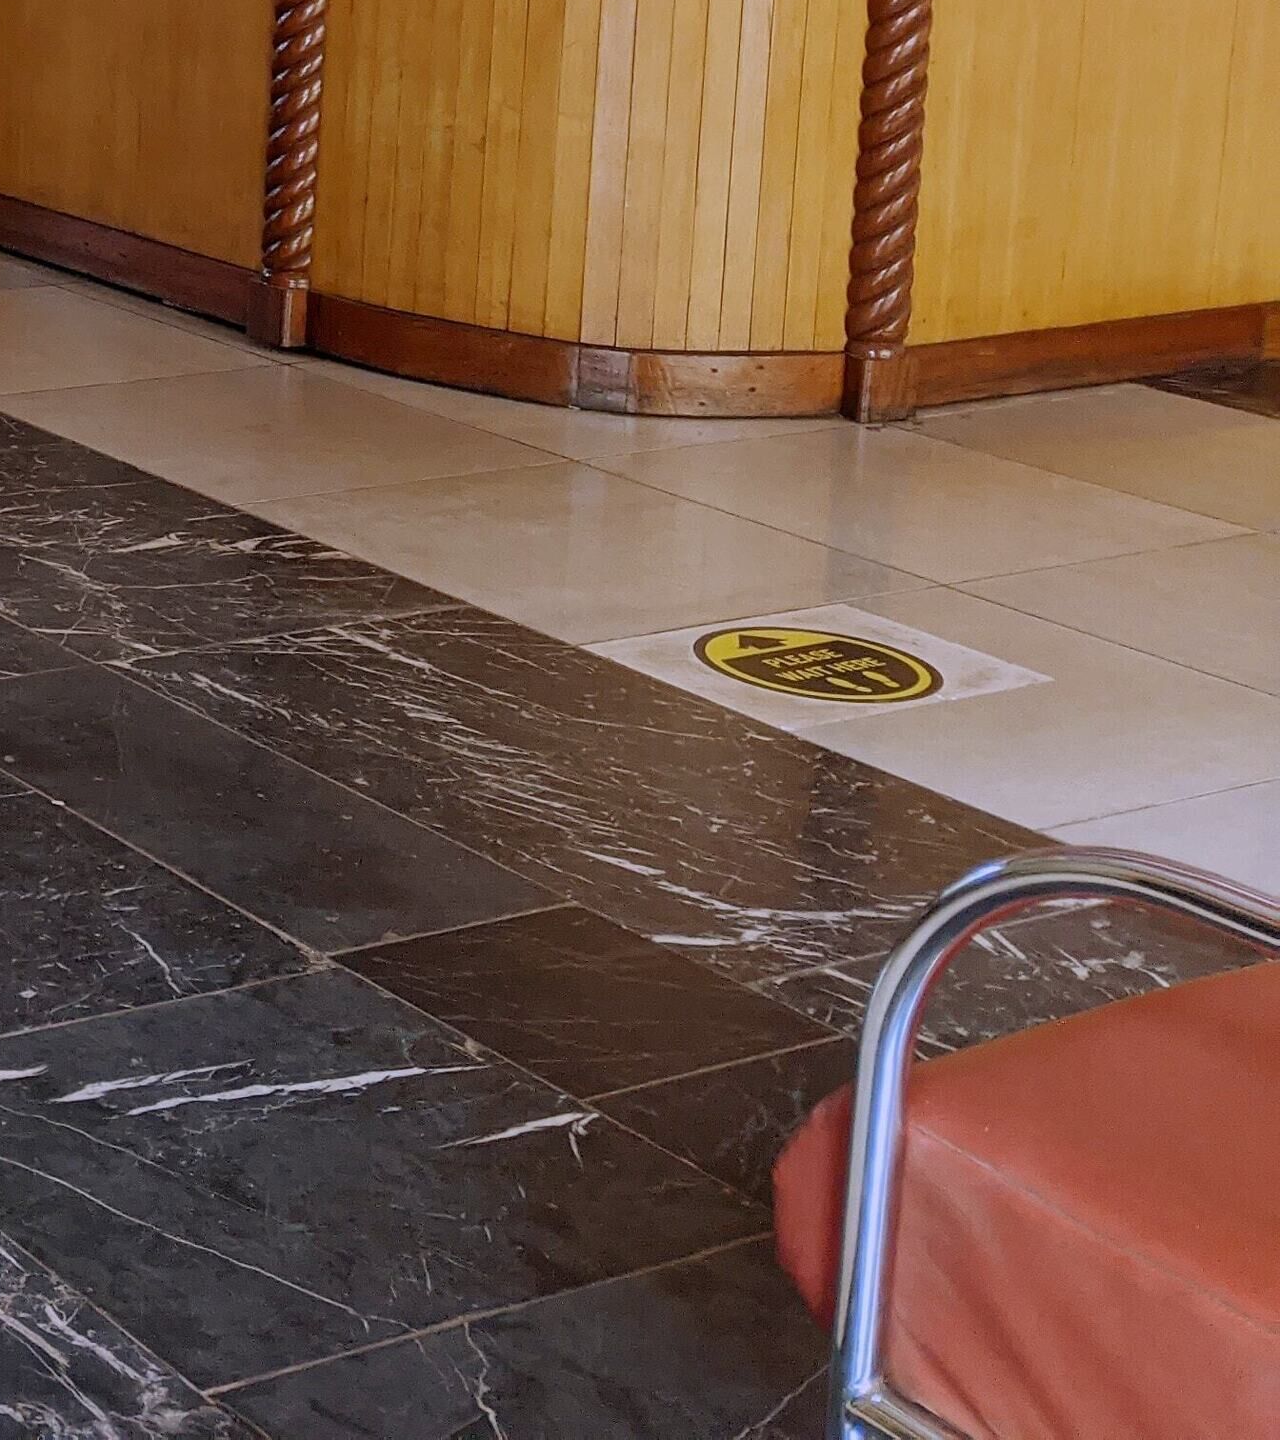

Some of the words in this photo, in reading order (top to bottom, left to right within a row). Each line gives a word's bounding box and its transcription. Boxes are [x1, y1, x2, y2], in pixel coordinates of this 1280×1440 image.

[761, 648, 843, 668] PLEASE
[775, 665, 833, 682] WAIT
[826, 656, 887, 673] HERE
